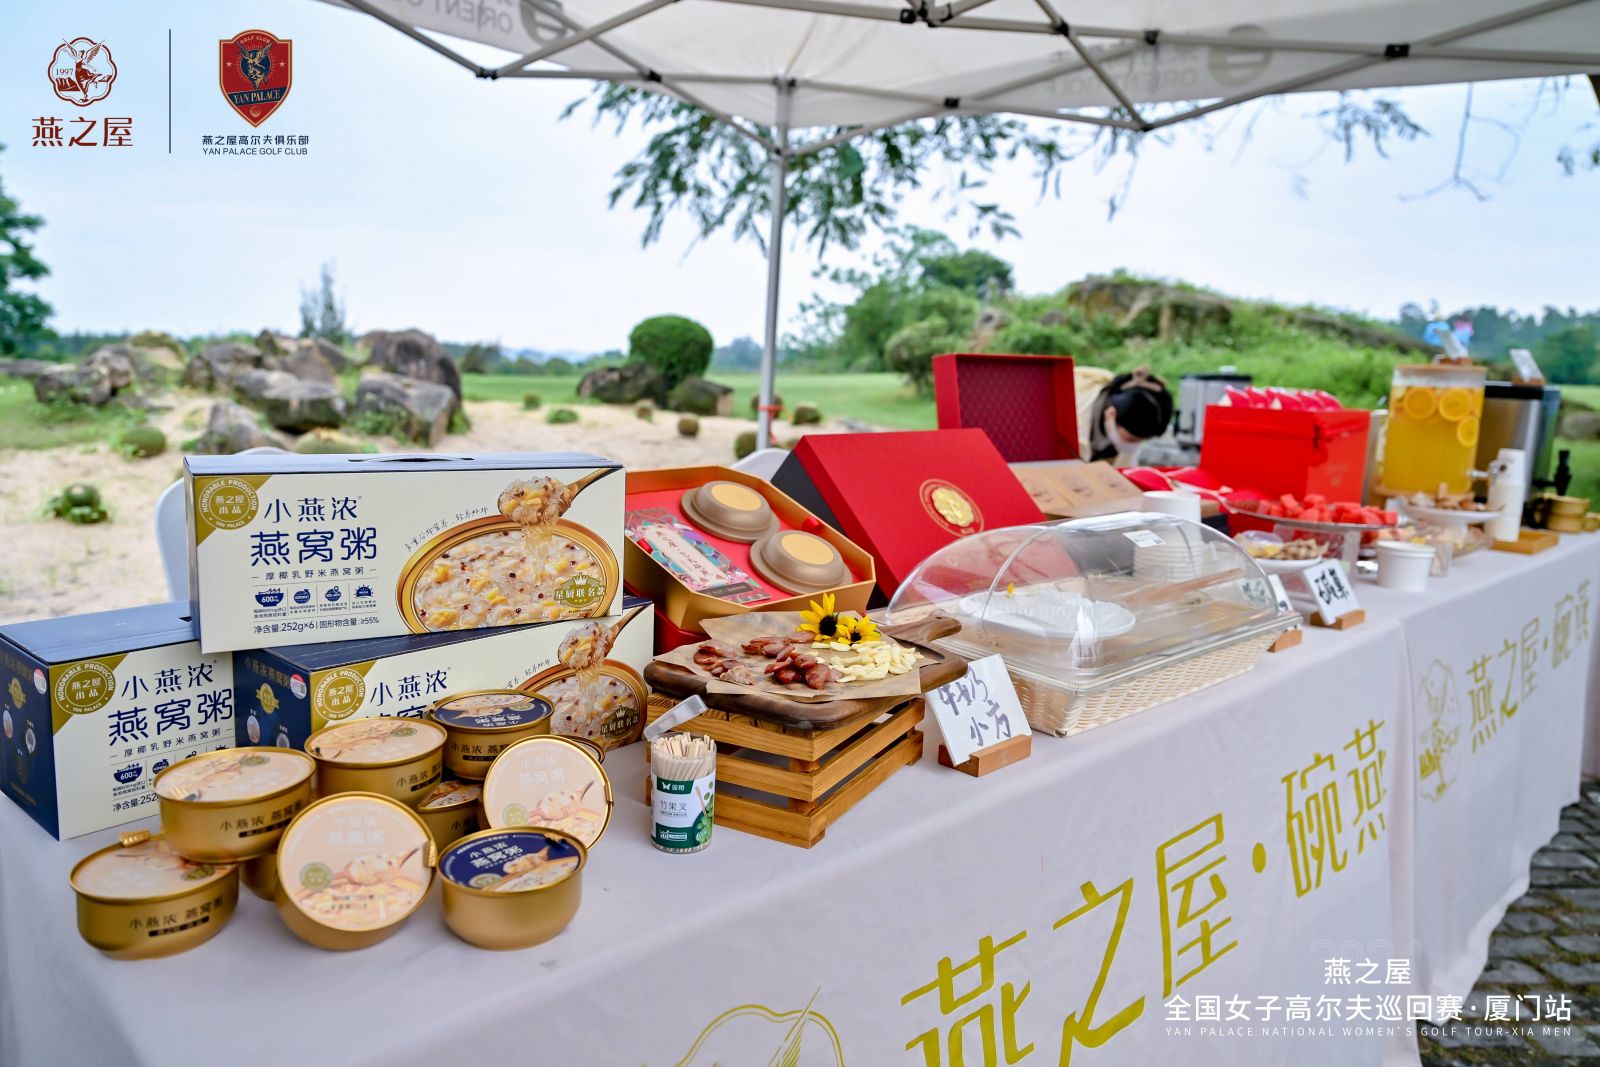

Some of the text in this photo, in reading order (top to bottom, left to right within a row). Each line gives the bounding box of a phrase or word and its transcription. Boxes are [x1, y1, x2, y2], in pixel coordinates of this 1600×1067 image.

[202, 479, 257, 513] HONORABLE PRODUCTION
[215, 495, 245, 505] 燕之屋
[264, 496, 358, 524] 小燕浓
[250, 527, 377, 567] 燕窝粥
[265, 566, 364, 581] 厚椰乳野米燕窝粥
[56, 663, 82, 702] HONORABLE
[84, 662, 115, 692] PRODUCTION
[71, 678, 102, 691] 燕之屋
[121, 663, 214, 700] 小燕浓
[318, 673, 337, 708] HONORABLE
[340, 670, 364, 698] PRODUCTION
[370, 669, 448, 706] 小燕浓
[109, 688, 233, 746] 燕窝粥
[970, 700, 1011, 747] 小方
[124, 728, 221, 758] 厚椰乳野米燕窝粥
[120, 772, 133, 780] 600
[660, 800, 688, 812] 竹果叉
[219, 815, 265, 832] 小燕浓
[128, 912, 178, 931] 小燕浓
